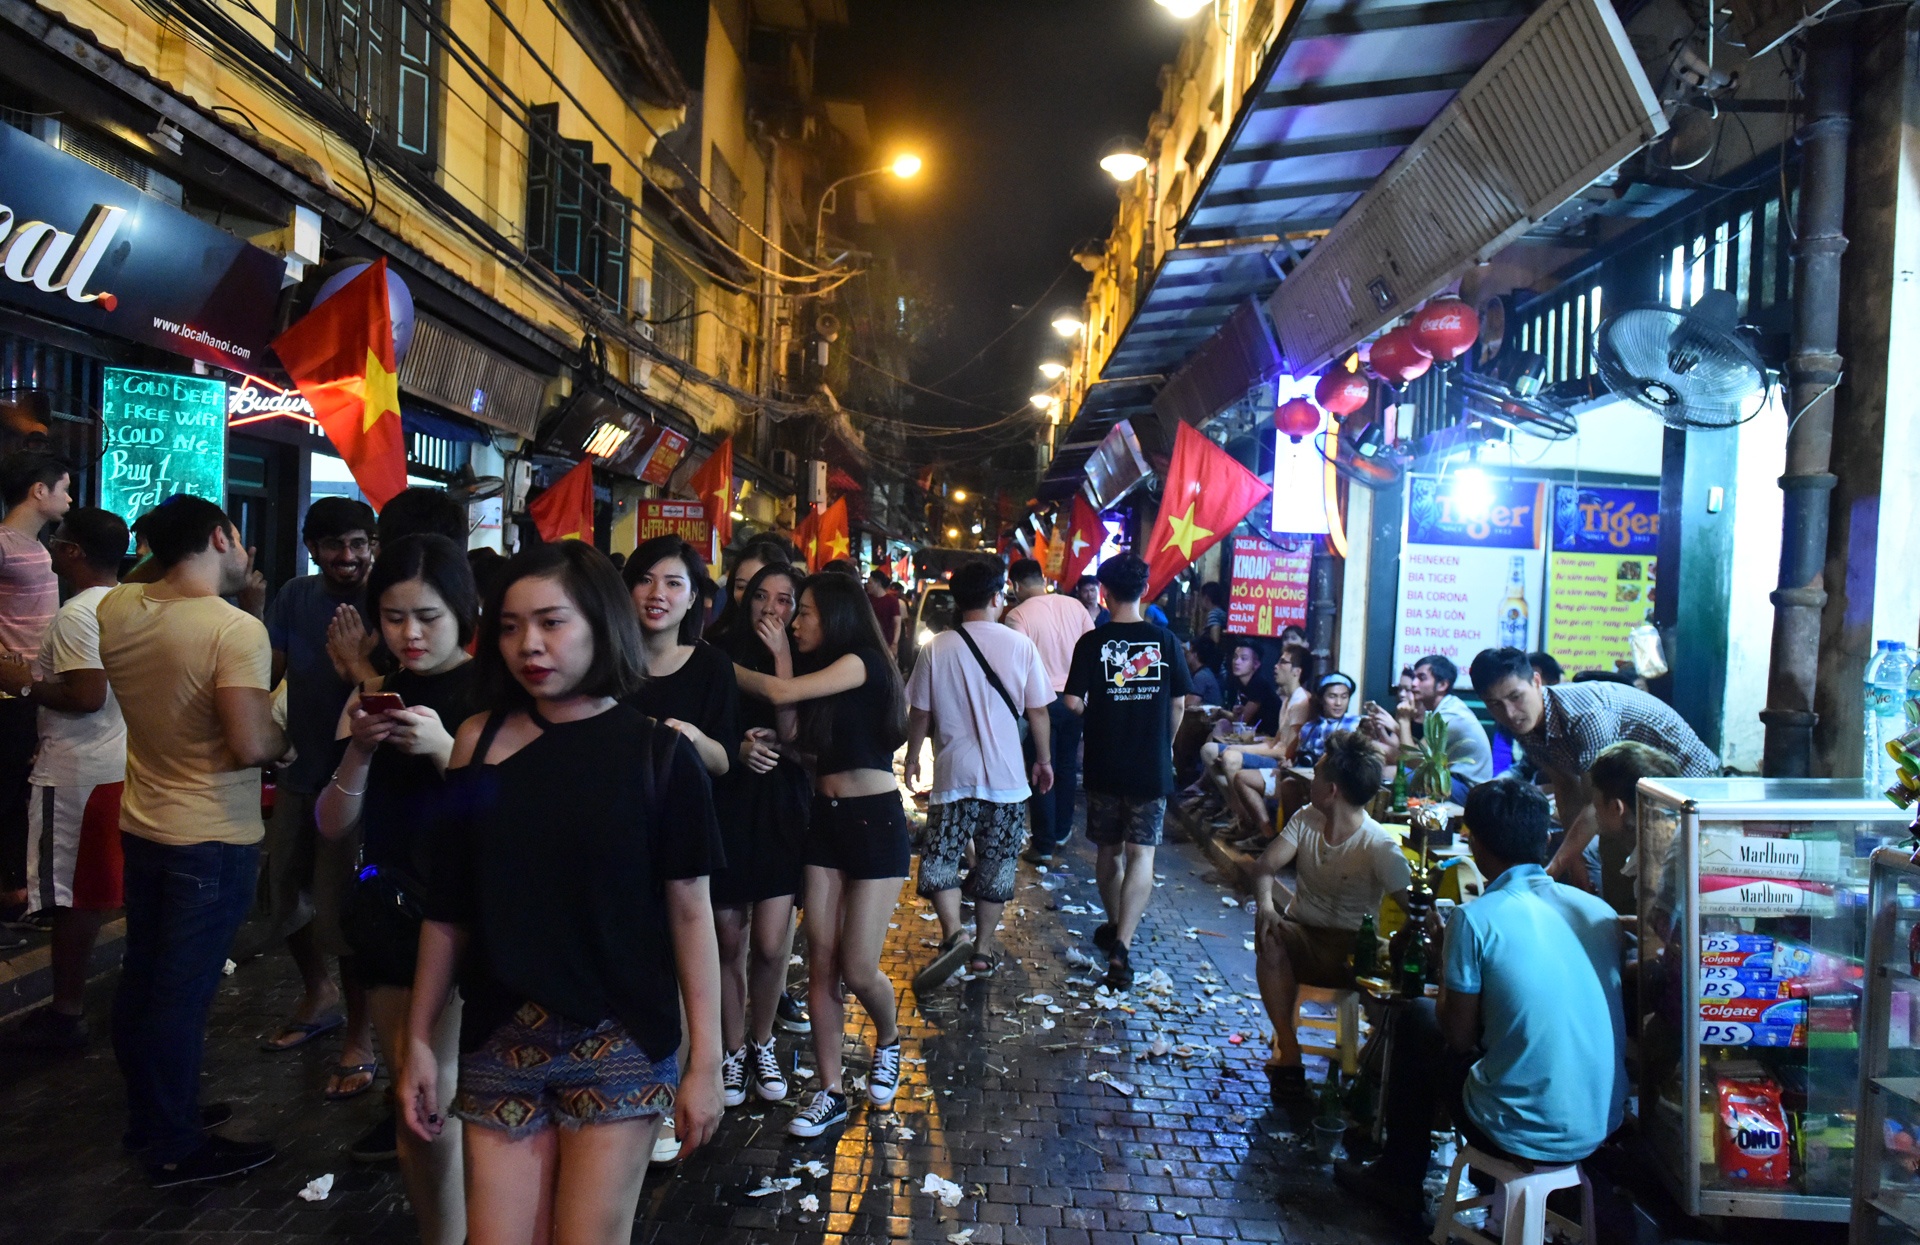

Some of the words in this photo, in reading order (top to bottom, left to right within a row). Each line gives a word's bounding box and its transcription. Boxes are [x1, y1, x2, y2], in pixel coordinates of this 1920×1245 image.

[152, 316, 251, 360] www.localhanoi.com
[123, 376, 169, 397] COLD
[124, 405, 170, 421] FREE
[119, 426, 164, 444] COLD
[108, 449, 152, 490] Buy
[155, 454, 171, 480] 1
[1579, 501, 1659, 547] Tiger
[1233, 555, 1267, 580] KHOAI
[1409, 554, 1459, 566] HEINEKEN
[1408, 572, 1425, 582] BIA
[1428, 573, 1456, 584] TIGER
[1407, 591, 1423, 601] BIA
[1426, 591, 1468, 603] CORONA
[1406, 609, 1423, 619] BIA
[1405, 627, 1422, 636] BIA
[1404, 645, 1420, 654] BIA
[1740, 842, 1799, 864] Marlboro
[1740, 884, 1793, 904] Marlboro
[1702, 955, 1740, 964] Colgate
[1699, 1005, 1758, 1018] Colgate
[1738, 1128, 1780, 1149] OMO
